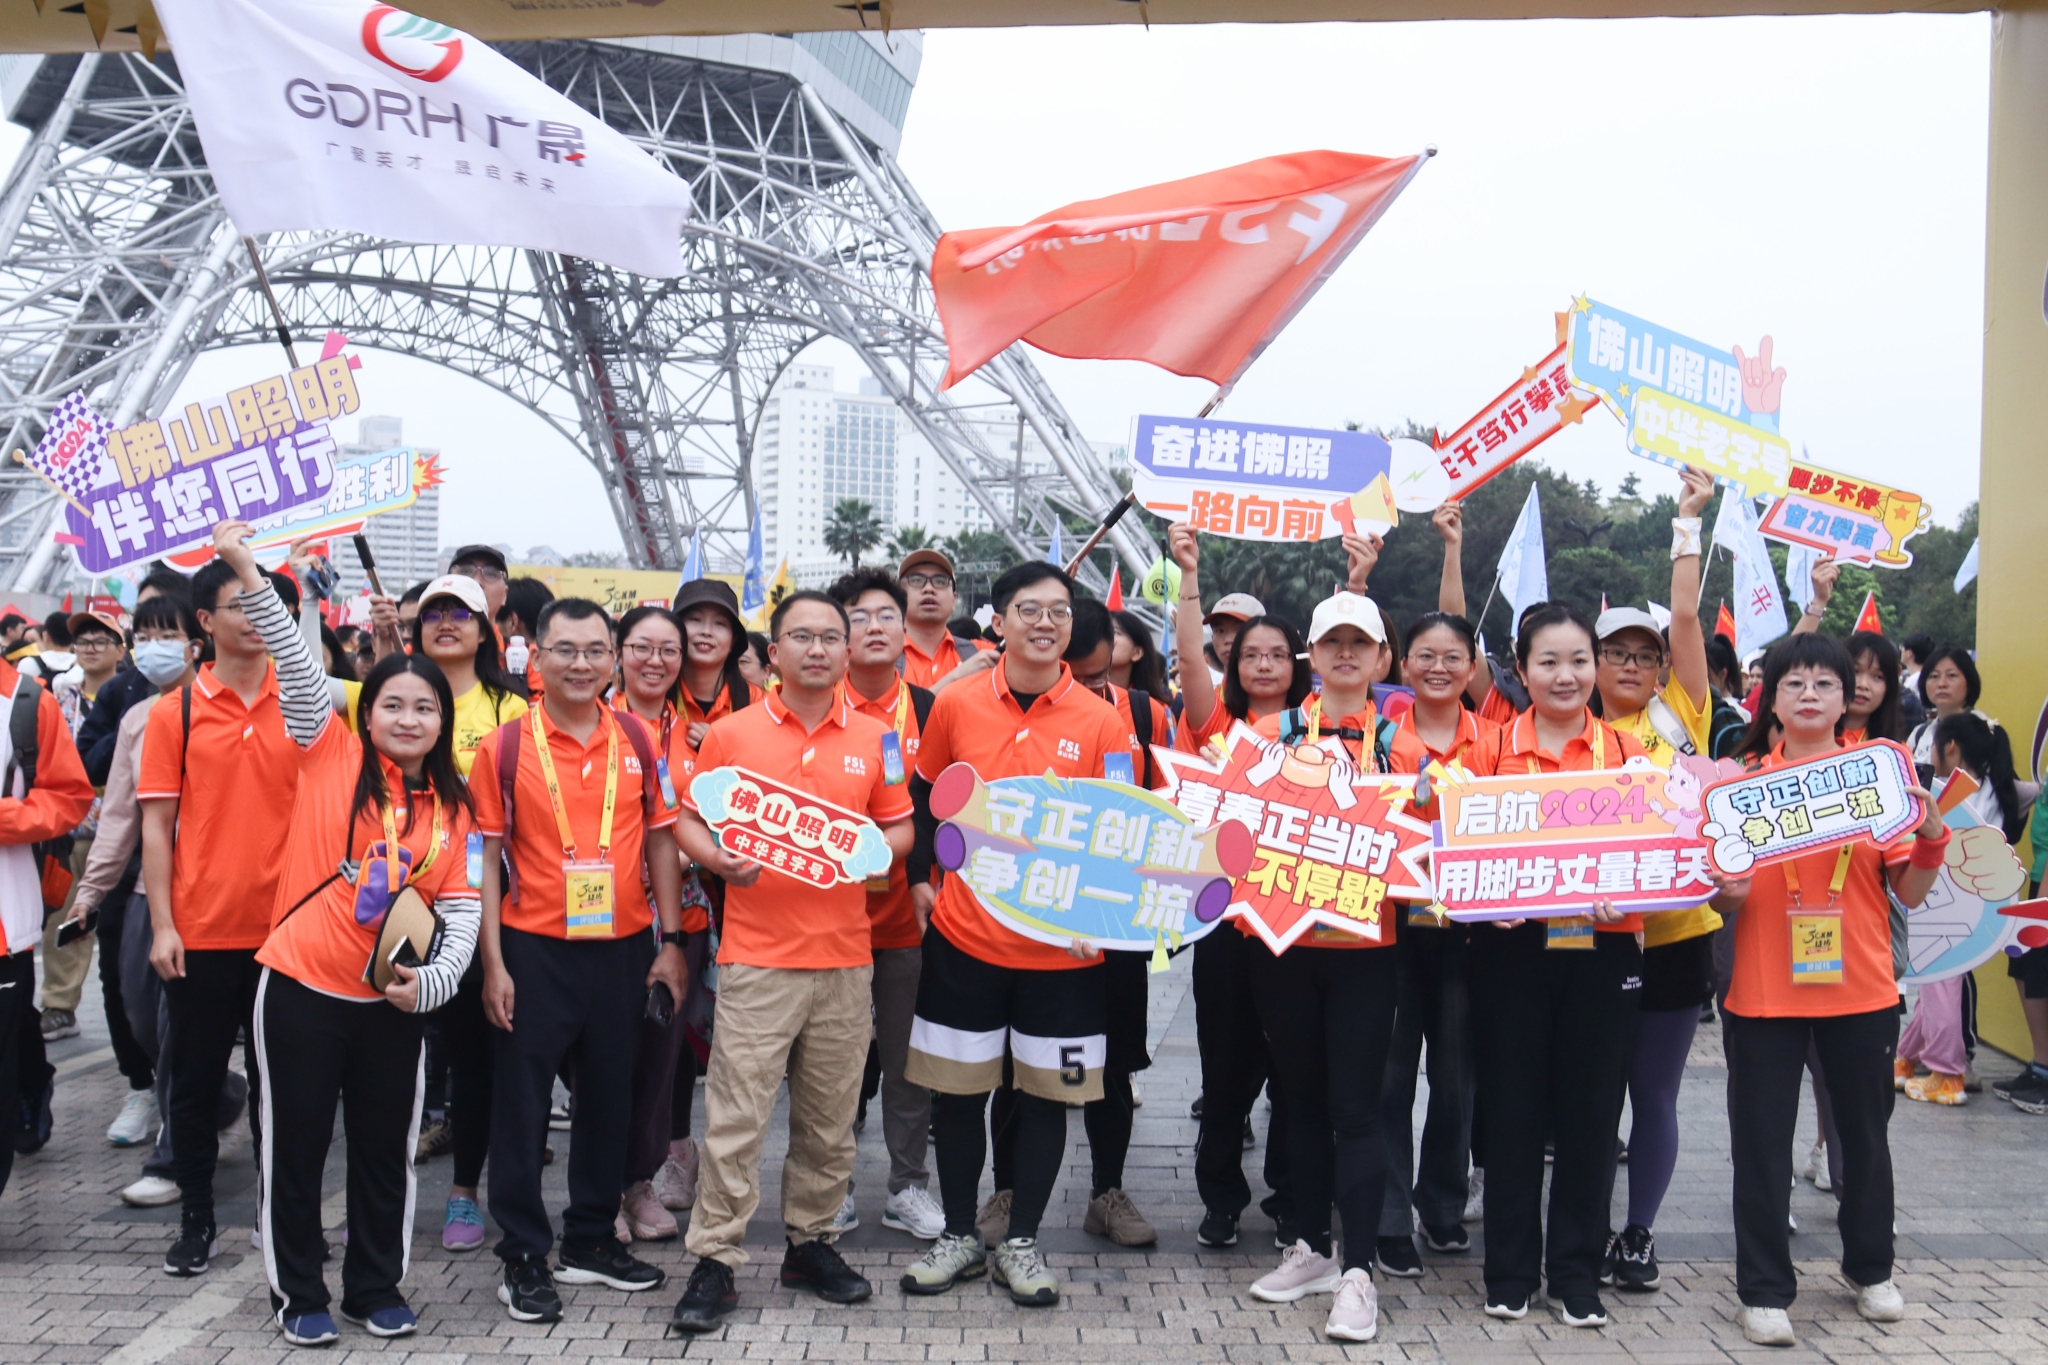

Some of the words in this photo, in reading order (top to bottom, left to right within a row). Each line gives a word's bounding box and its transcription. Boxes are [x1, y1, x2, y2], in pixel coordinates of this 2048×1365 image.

[284, 77, 465, 143] GDRH
[487, 113, 586, 168] 广晟
[1588, 313, 1743, 417] 佛山照明
[51, 418, 94, 471] 2024
[106, 354, 360, 488] 佛山照明
[1637, 399, 1790, 488] 中华老字号
[1151, 424, 1331, 481] 奋进佛照
[92, 424, 336, 559] 伴您同行
[1146, 490, 1326, 542] 一路向前
[1789, 466, 1882, 511] 脚步不停
[1784, 504, 1878, 550] 奋力攀高
[843, 755, 865, 769] FSL
[1058, 738, 1080, 755] FSL
[1729, 755, 1878, 816] 守正创新
[731, 787, 860, 854] 佛山照明
[980, 786, 1207, 873] 守正创新
[1740, 788, 1884, 847] 争创一流
[734, 834, 824, 881] 中华老字号
[1228, 848, 1388, 925] 不停歇
[1438, 847, 1715, 901] 用脚步丈量春天
[967, 846, 1193, 932] 争创一流
[1059, 1044, 1086, 1086] 5
